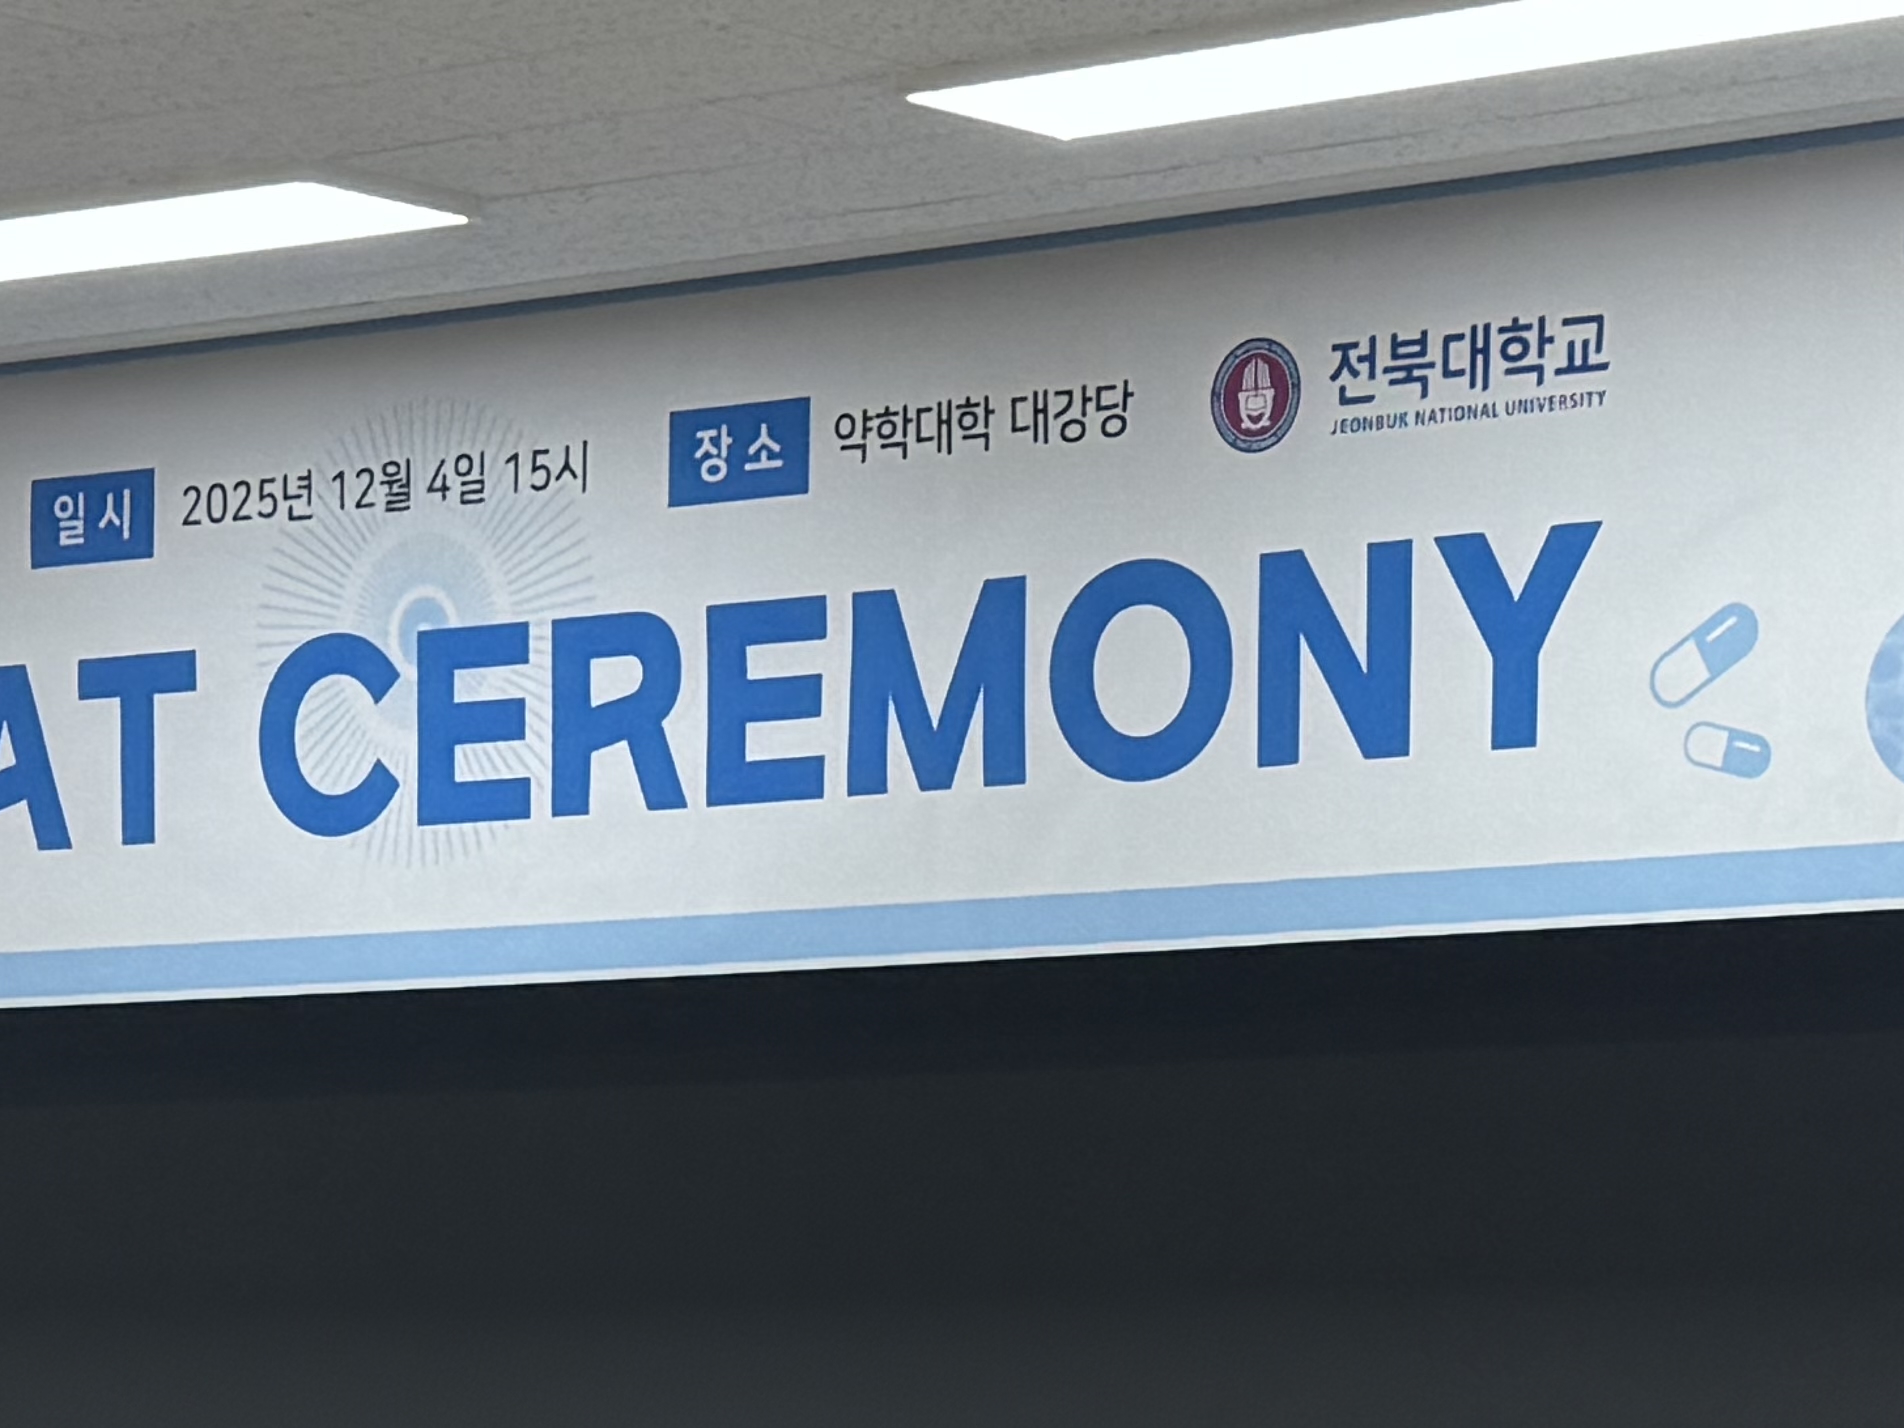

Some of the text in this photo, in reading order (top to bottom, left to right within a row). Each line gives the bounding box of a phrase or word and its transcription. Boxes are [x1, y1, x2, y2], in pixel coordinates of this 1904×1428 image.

[1329, 314, 1610, 406] 전북대학교
[834, 394, 995, 463] 약학대학
[1010, 378, 1135, 444] 대강당
[1330, 390, 1607, 435] JEONBUK NATIONAL UNIVERSITY
[181, 468, 314, 527] 2025년
[331, 457, 412, 513] 12월
[426, 450, 486, 505] 4일
[506, 440, 589, 495] 15시
[258, 520, 1603, 838] CEREMONY
